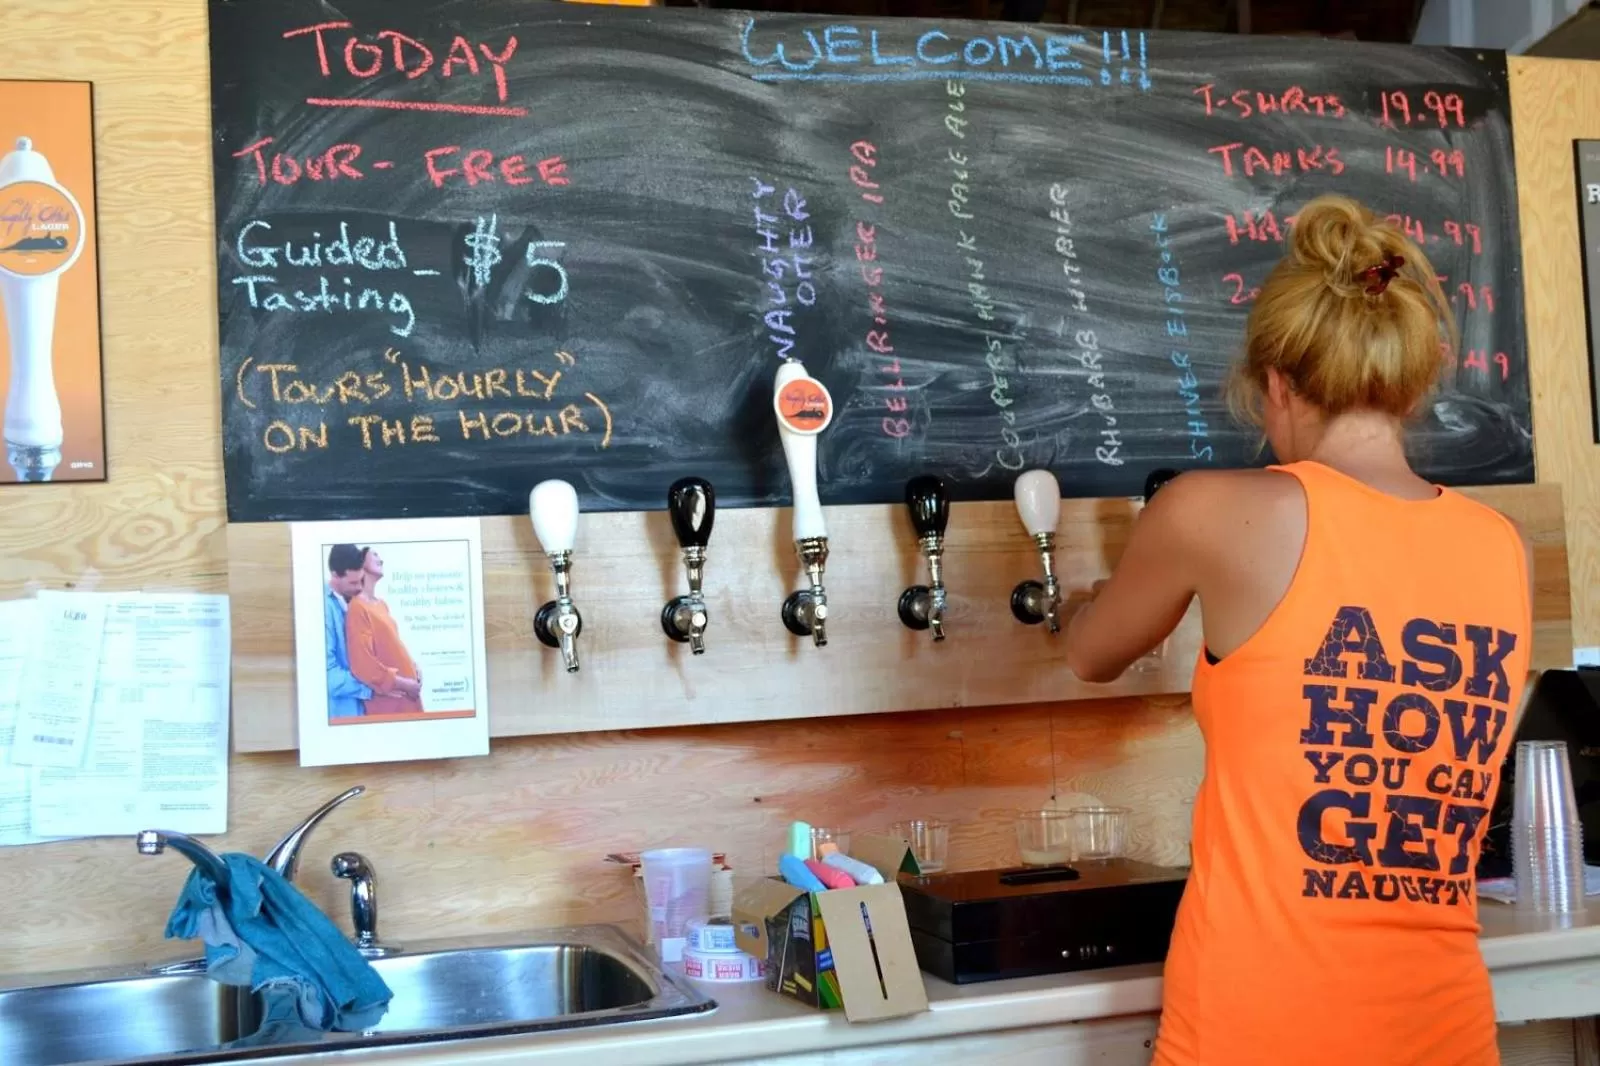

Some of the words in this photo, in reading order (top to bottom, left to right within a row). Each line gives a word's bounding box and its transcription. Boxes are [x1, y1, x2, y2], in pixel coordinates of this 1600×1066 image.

[283, 21, 518, 101] TODAY
[742, 17, 1152, 91] WELCOME!!!
[944, 80, 968, 140] ALE
[1380, 90, 1466, 129] 19.99
[424, 145, 572, 188] FREE
[849, 139, 885, 204] IPA
[948, 150, 976, 220] PALE
[1208, 142, 1345, 178] TANKS
[1385, 145, 1466, 182] 14.99
[236, 220, 407, 271] Guided
[749, 174, 793, 360] NAUGHTY
[1049, 182, 1089, 313] WITBIER
[232, 275, 417, 338] Tasting
[1075, 328, 1123, 467] RHUBARB
[1172, 349, 1214, 461] SHIVER
[263, 419, 329, 454] ON
[348, 413, 440, 450] THE
[1303, 605, 1518, 705] ASK
[1300, 684, 1508, 766] HOW
[1303, 750, 1412, 790] YOU
[1296, 788, 1489, 876] GET
[1302, 868, 1473, 906] NAUGHTY
